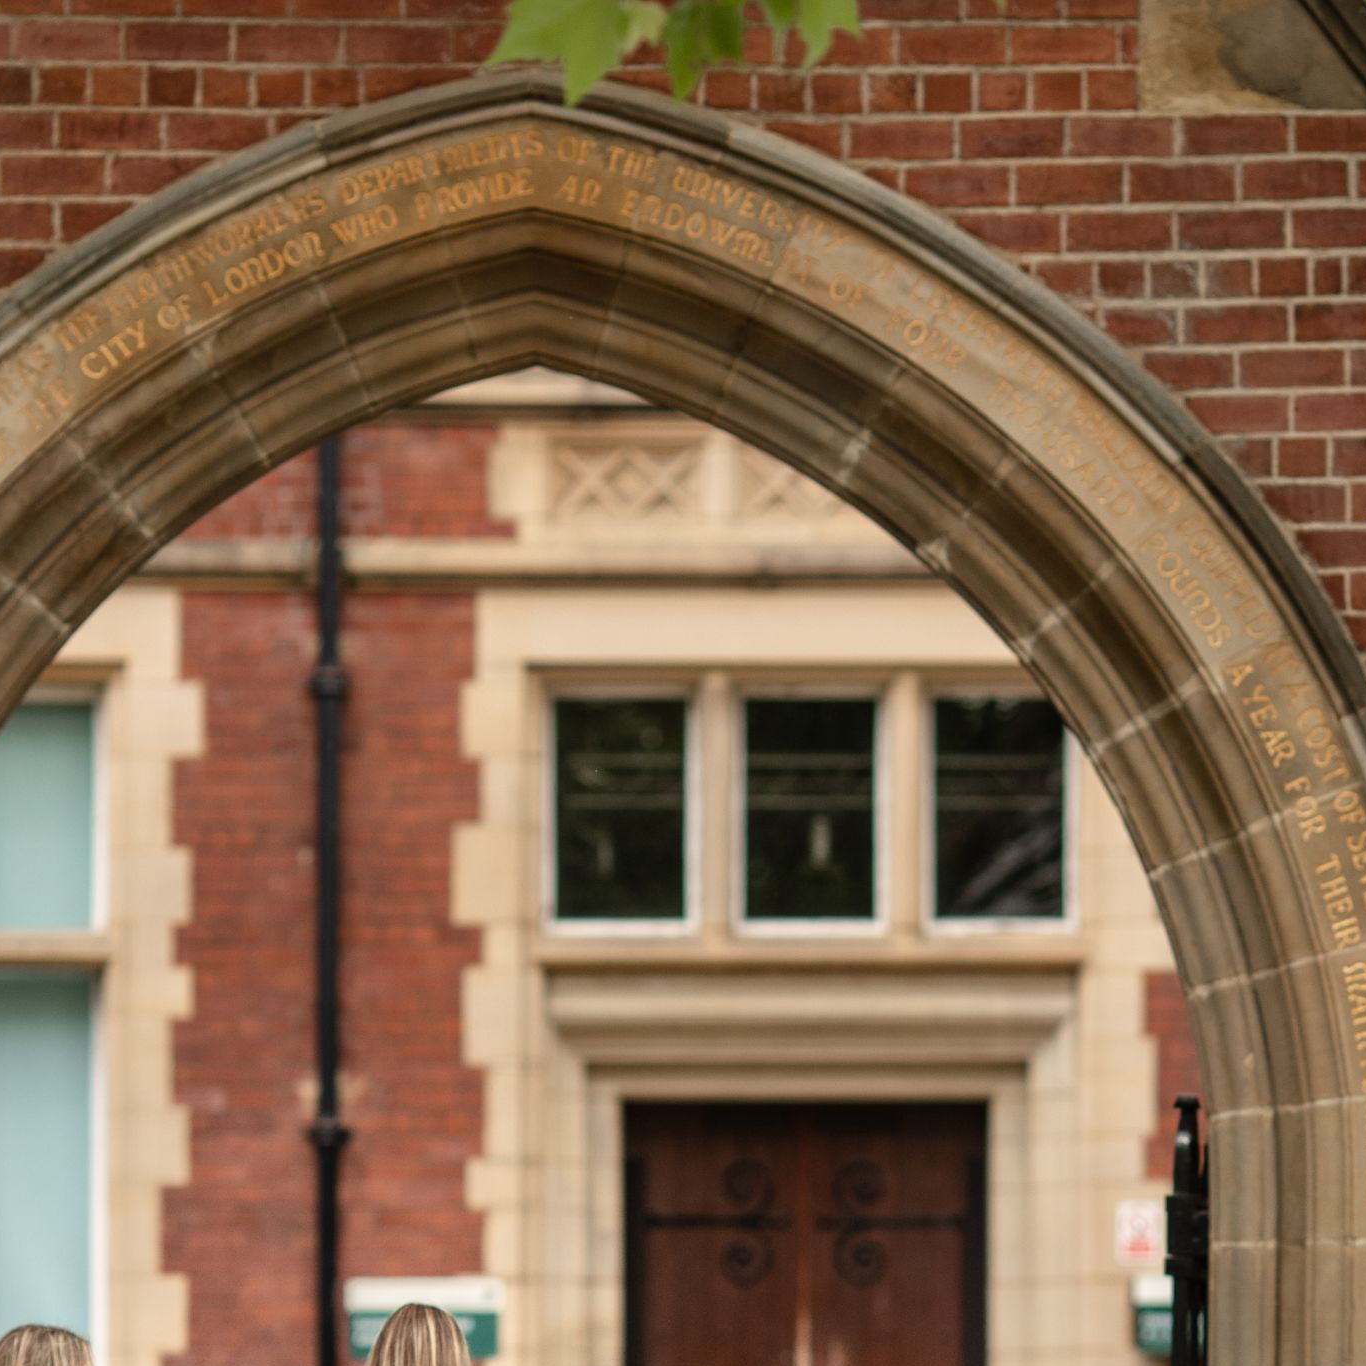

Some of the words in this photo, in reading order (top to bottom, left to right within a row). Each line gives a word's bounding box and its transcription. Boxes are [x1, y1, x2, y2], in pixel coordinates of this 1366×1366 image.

[329, 202, 398, 246] WHO
[412, 168, 534, 221] PROVIDE
[553, 174, 602, 207] AN
[201, 228, 325, 307] LONDON
[825, 271, 873, 314] OF
[152, 291, 199, 334] OF
[882, 304, 967, 373] FOUR
[76, 316, 156, 384] CITY
[9, 343, 56, 388] AS
[337, 132, 543, 205] DEPARTMENTS
[557, 135, 594, 166] OF
[602, 144, 659, 184] THE
[1292, 703, 1350, 787] COST
[1330, 788, 1366, 829] OF
[985, 377, 1139, 524] THOUSAND
[1138, 530, 1235, 649] POUNDS
[1225, 655, 1257, 687] A
[1238, 683, 1298, 766] YEAR
[1283, 775, 1328, 841] FOR
[1312, 852, 1362, 949] THEIR
